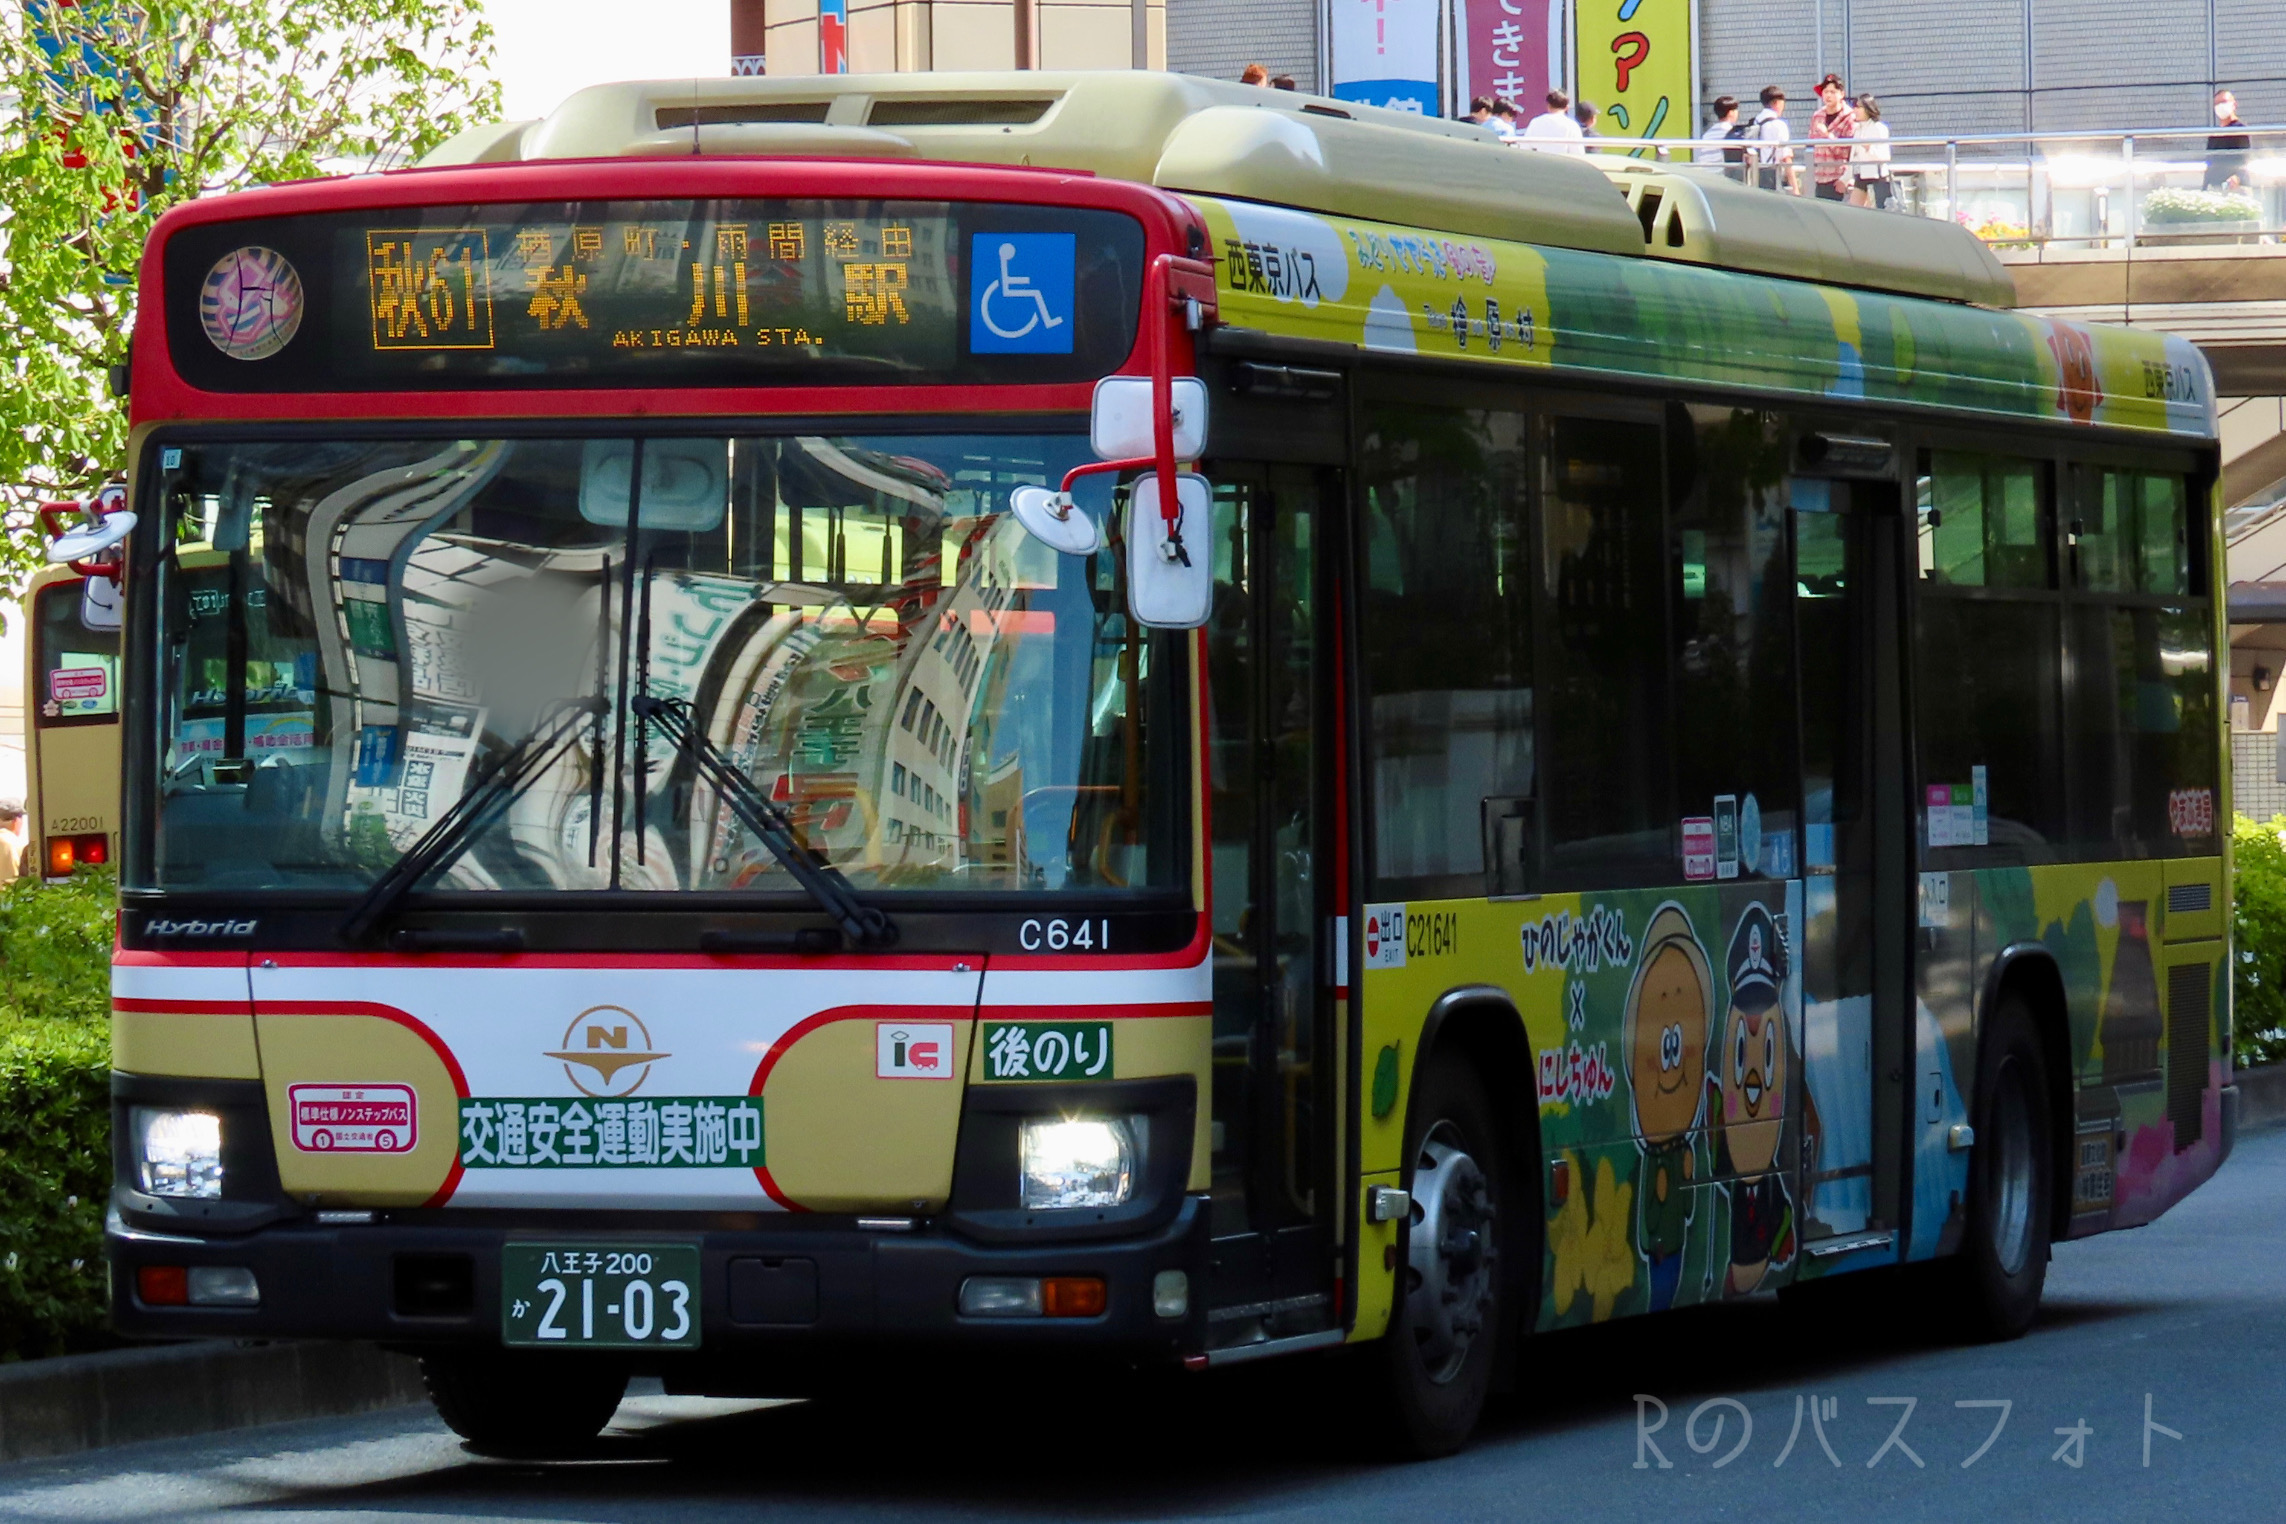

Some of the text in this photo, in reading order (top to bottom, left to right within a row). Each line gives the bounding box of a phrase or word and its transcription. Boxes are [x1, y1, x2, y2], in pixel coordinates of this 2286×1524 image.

[374, 242, 474, 337] 秋61
[1225, 239, 1321, 299] 西東京バス
[524, 262, 910, 329] 秋川駅
[613, 328, 823, 347] AKIGAWA STA.
[52, 816, 103, 832] A22001
[144, 919, 258, 935] Hybrid
[1019, 918, 1108, 950] C641
[1380, 911, 1402, 942] 出口
[1407, 912, 1457, 958] C21641
[1522, 907, 1632, 972] ひのじゃがくん
[988, 1025, 1108, 1077] 後のり
[462, 1100, 760, 1165] 交通安全運動実施中
[537, 1278, 690, 1340] 21-03
